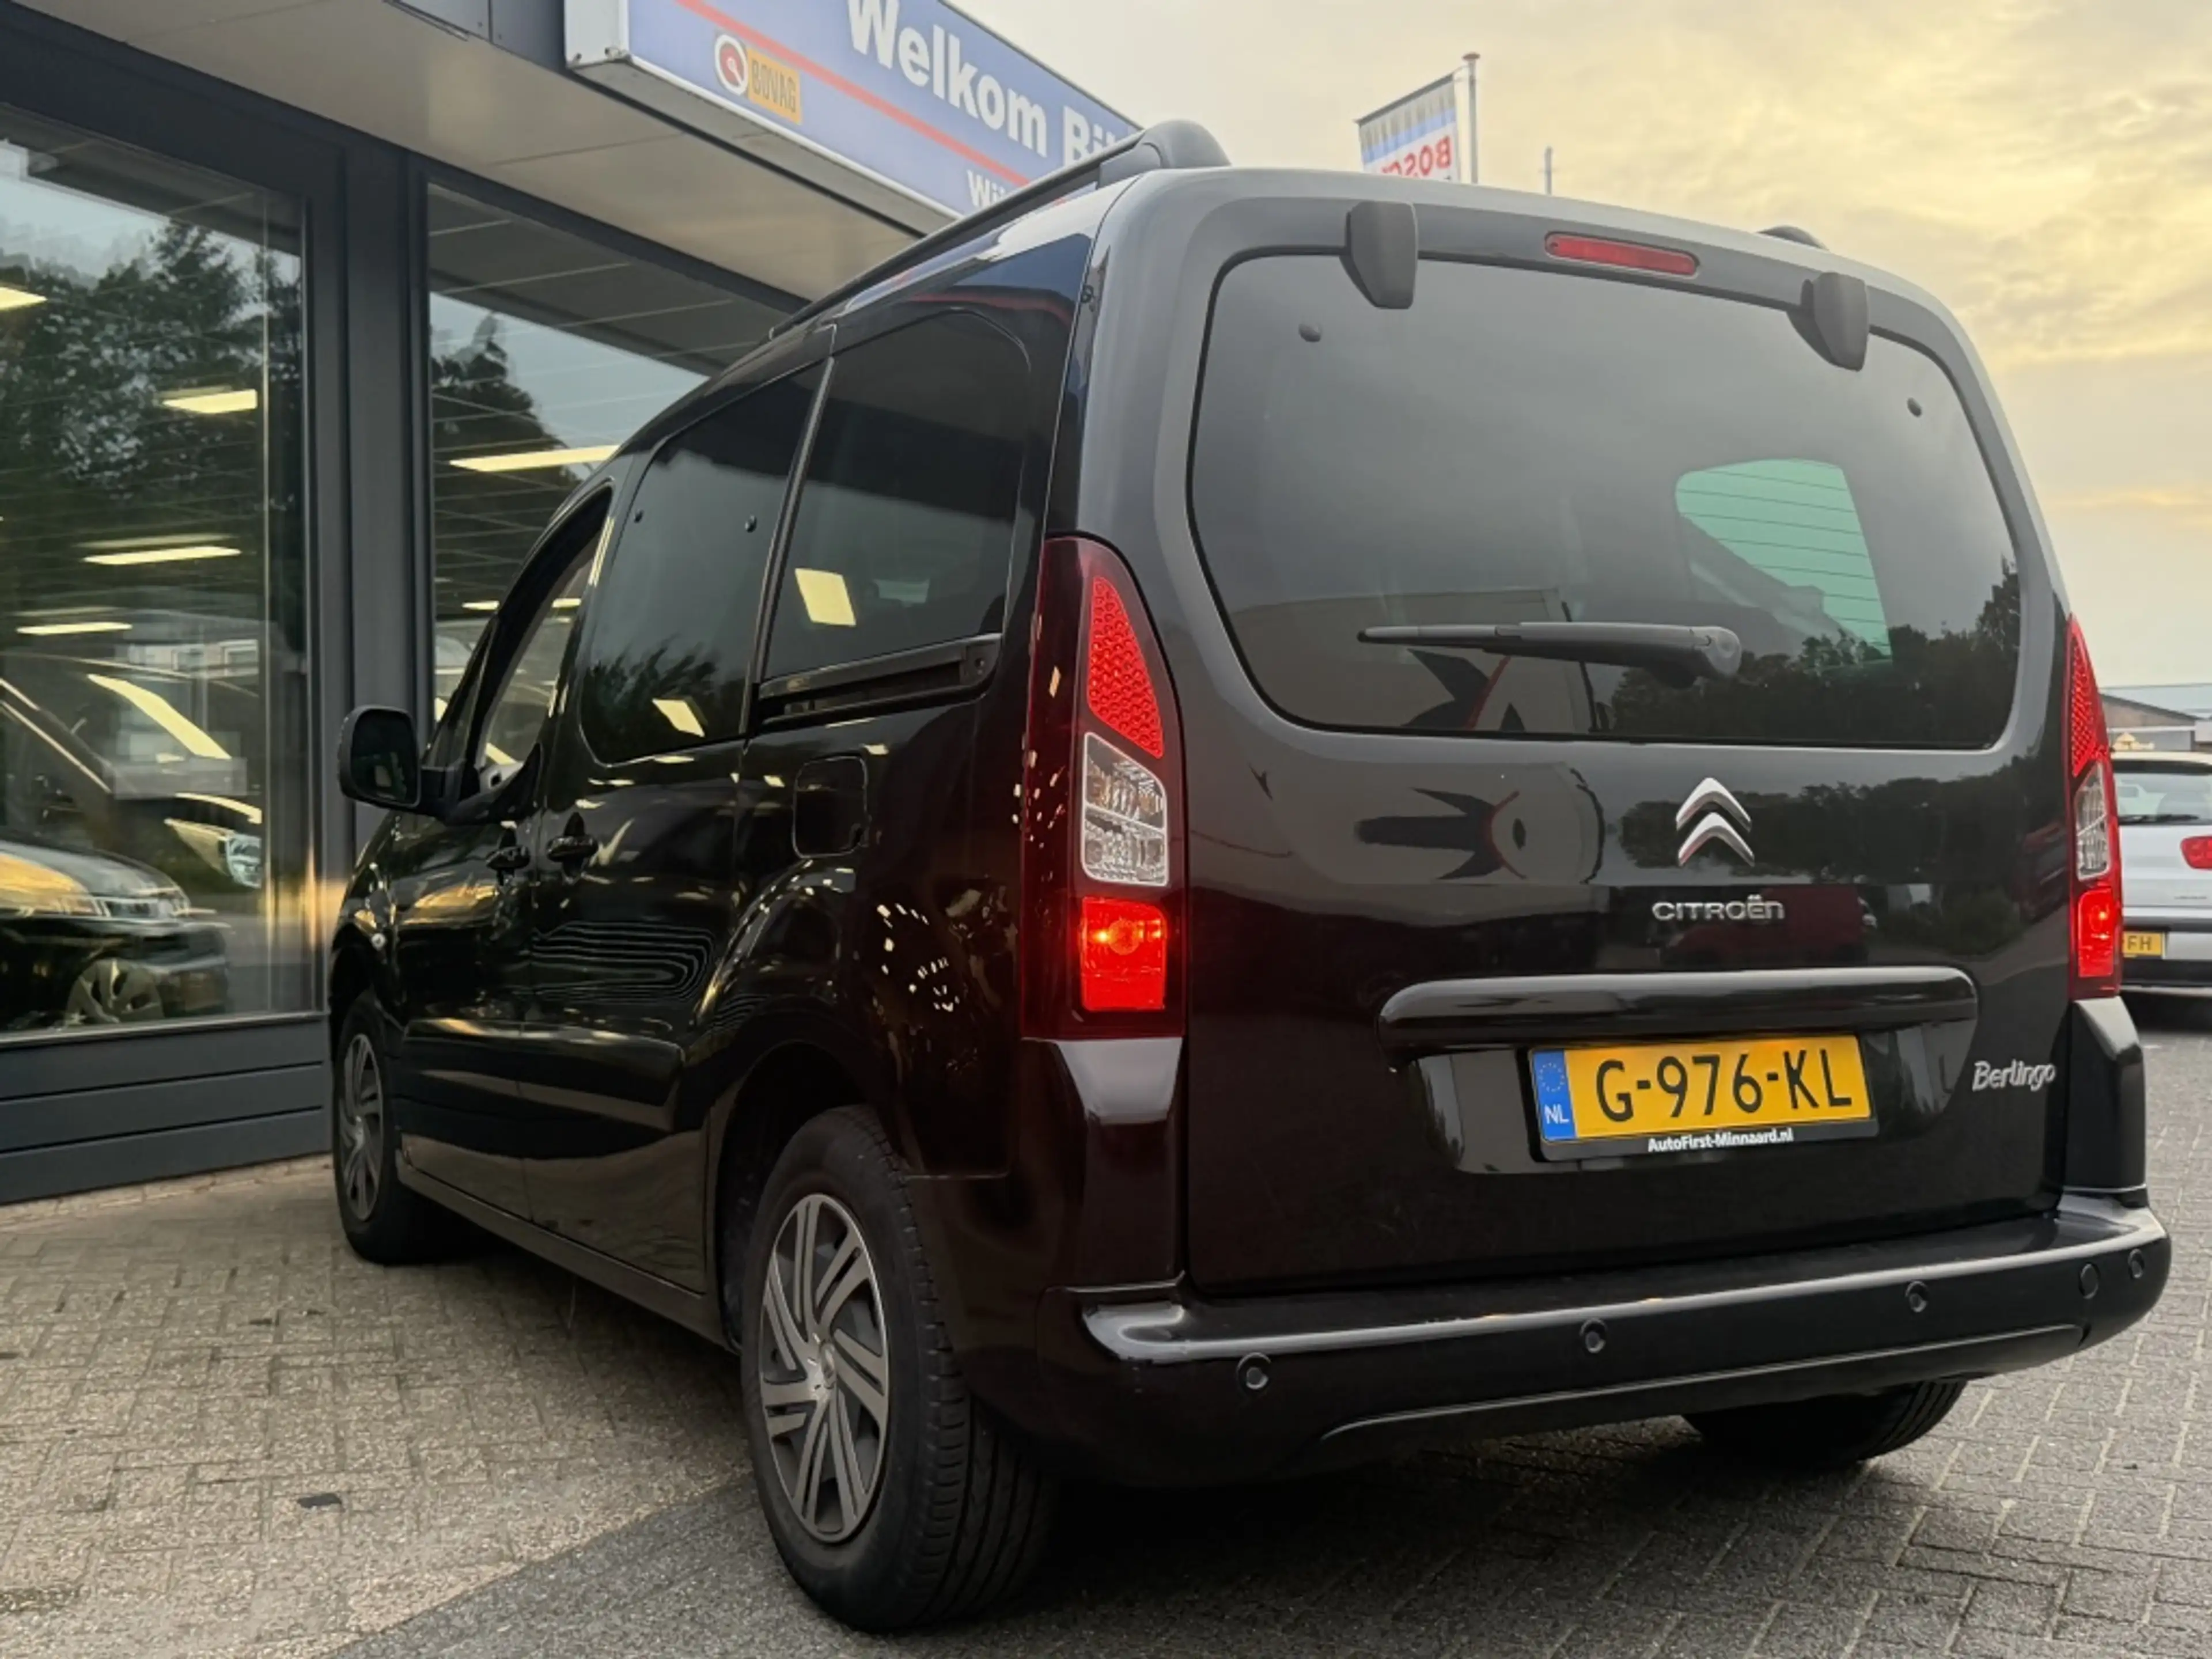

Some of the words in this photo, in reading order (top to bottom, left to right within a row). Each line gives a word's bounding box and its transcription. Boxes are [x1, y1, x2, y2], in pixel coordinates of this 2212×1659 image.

[751, 59, 796, 113] BOVAG
[847, 0, 1047, 157] Welkom
[1596, 1048, 1853, 1123] G-976-KL
[1972, 1058, 2056, 1092] Berlingo
[1544, 1103, 1570, 1125] NL
[1647, 1127, 1794, 1153] AutoFirst-Minnaard.nl
